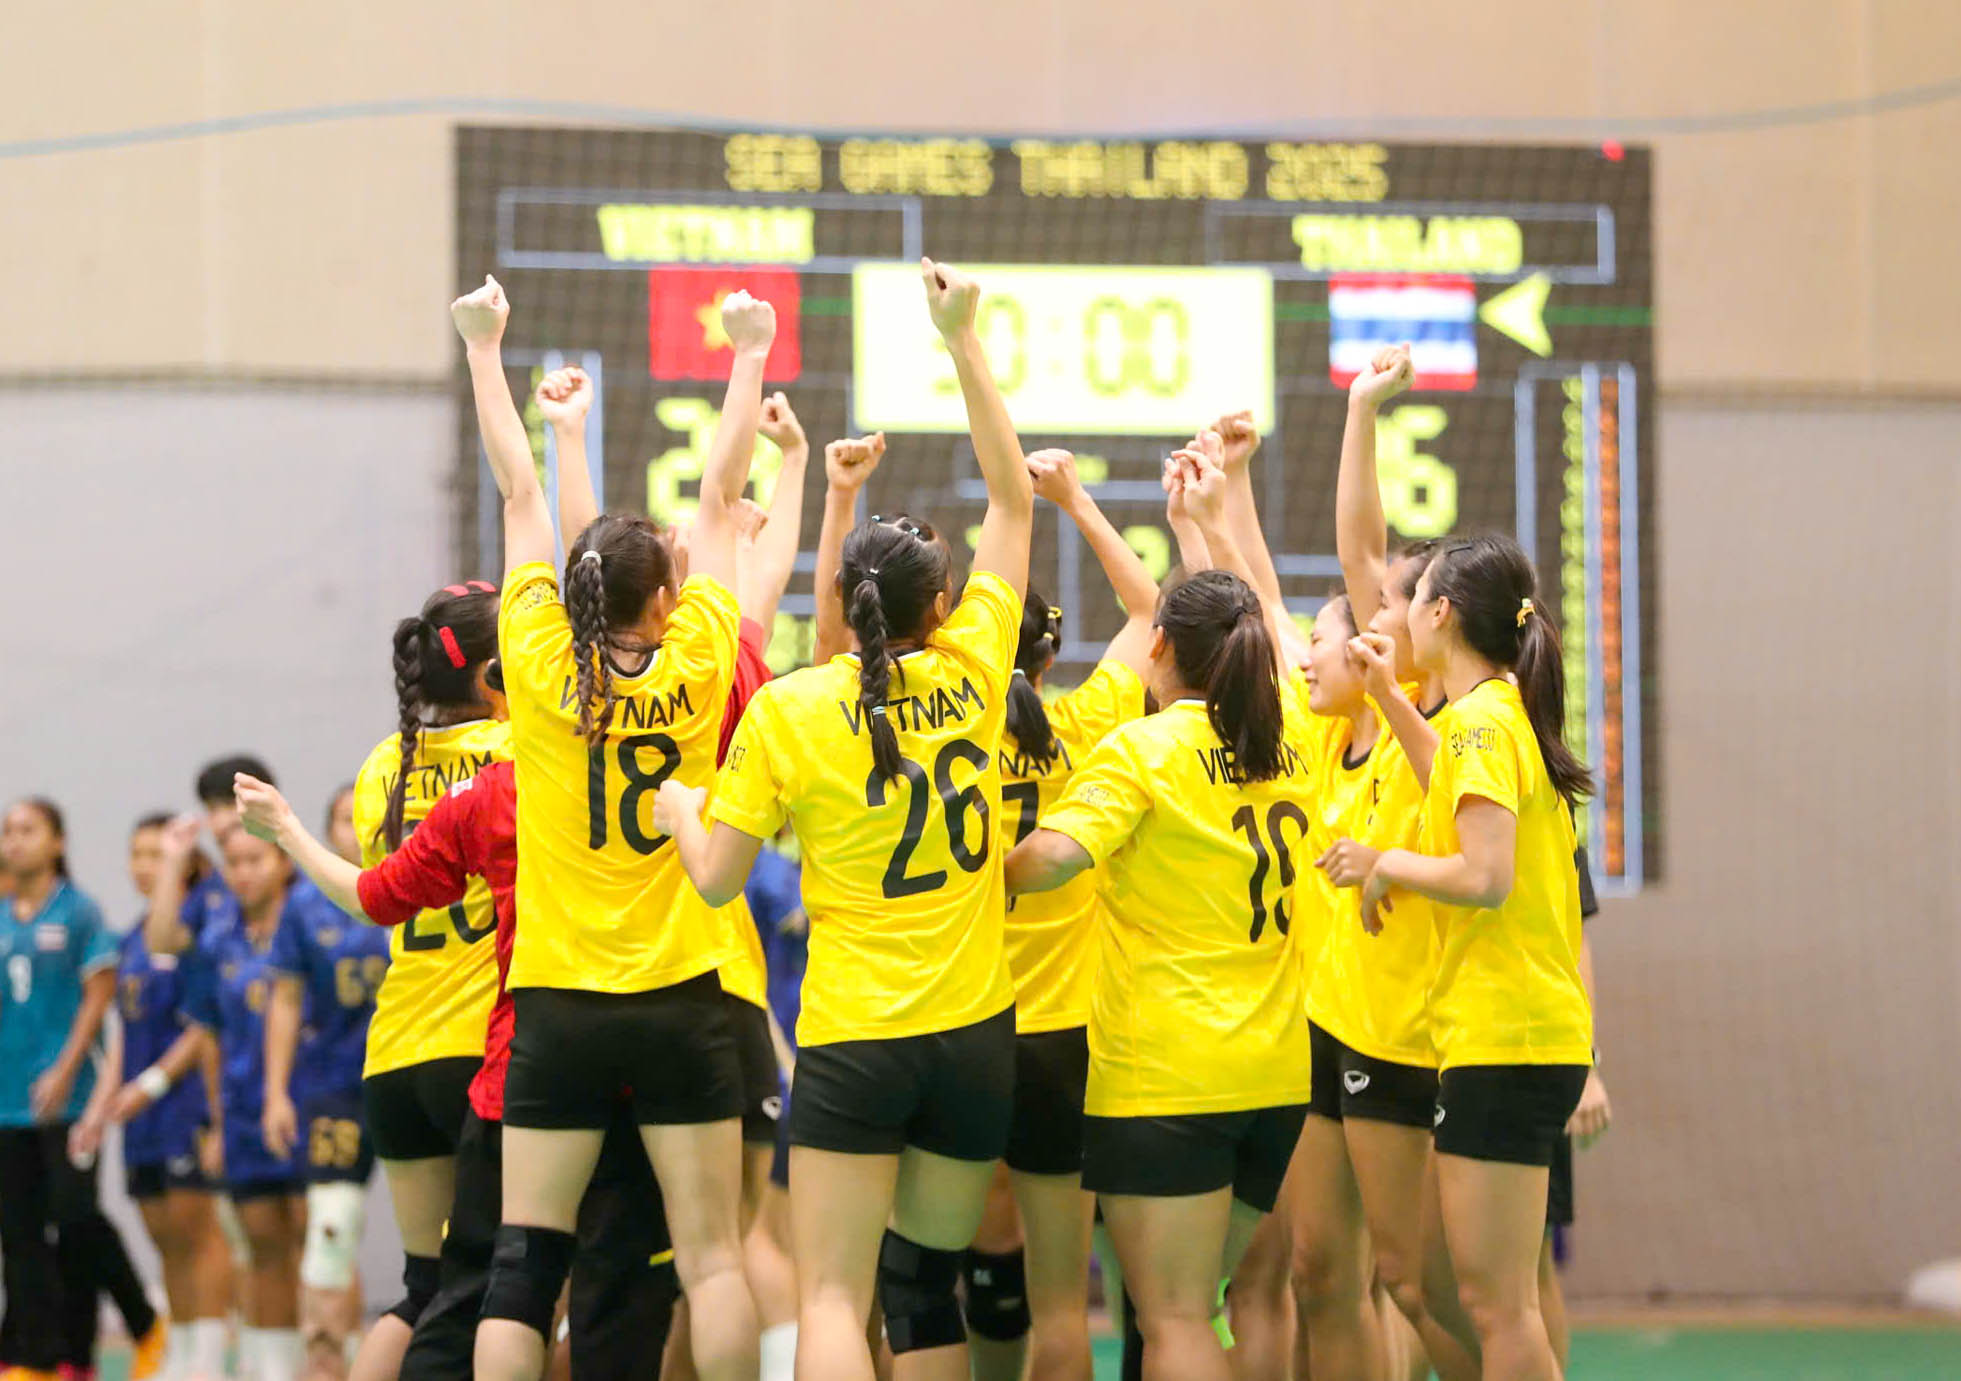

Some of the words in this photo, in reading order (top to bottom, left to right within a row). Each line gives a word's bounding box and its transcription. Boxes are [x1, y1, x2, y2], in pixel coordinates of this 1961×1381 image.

[725, 134, 822, 192] SEA
[839, 138, 994, 196] GAMES
[1011, 139, 1249, 198] THAILAND
[932, 294, 1193, 398] 0:00
[588, 733, 682, 855] 18
[866, 739, 989, 898] 26
